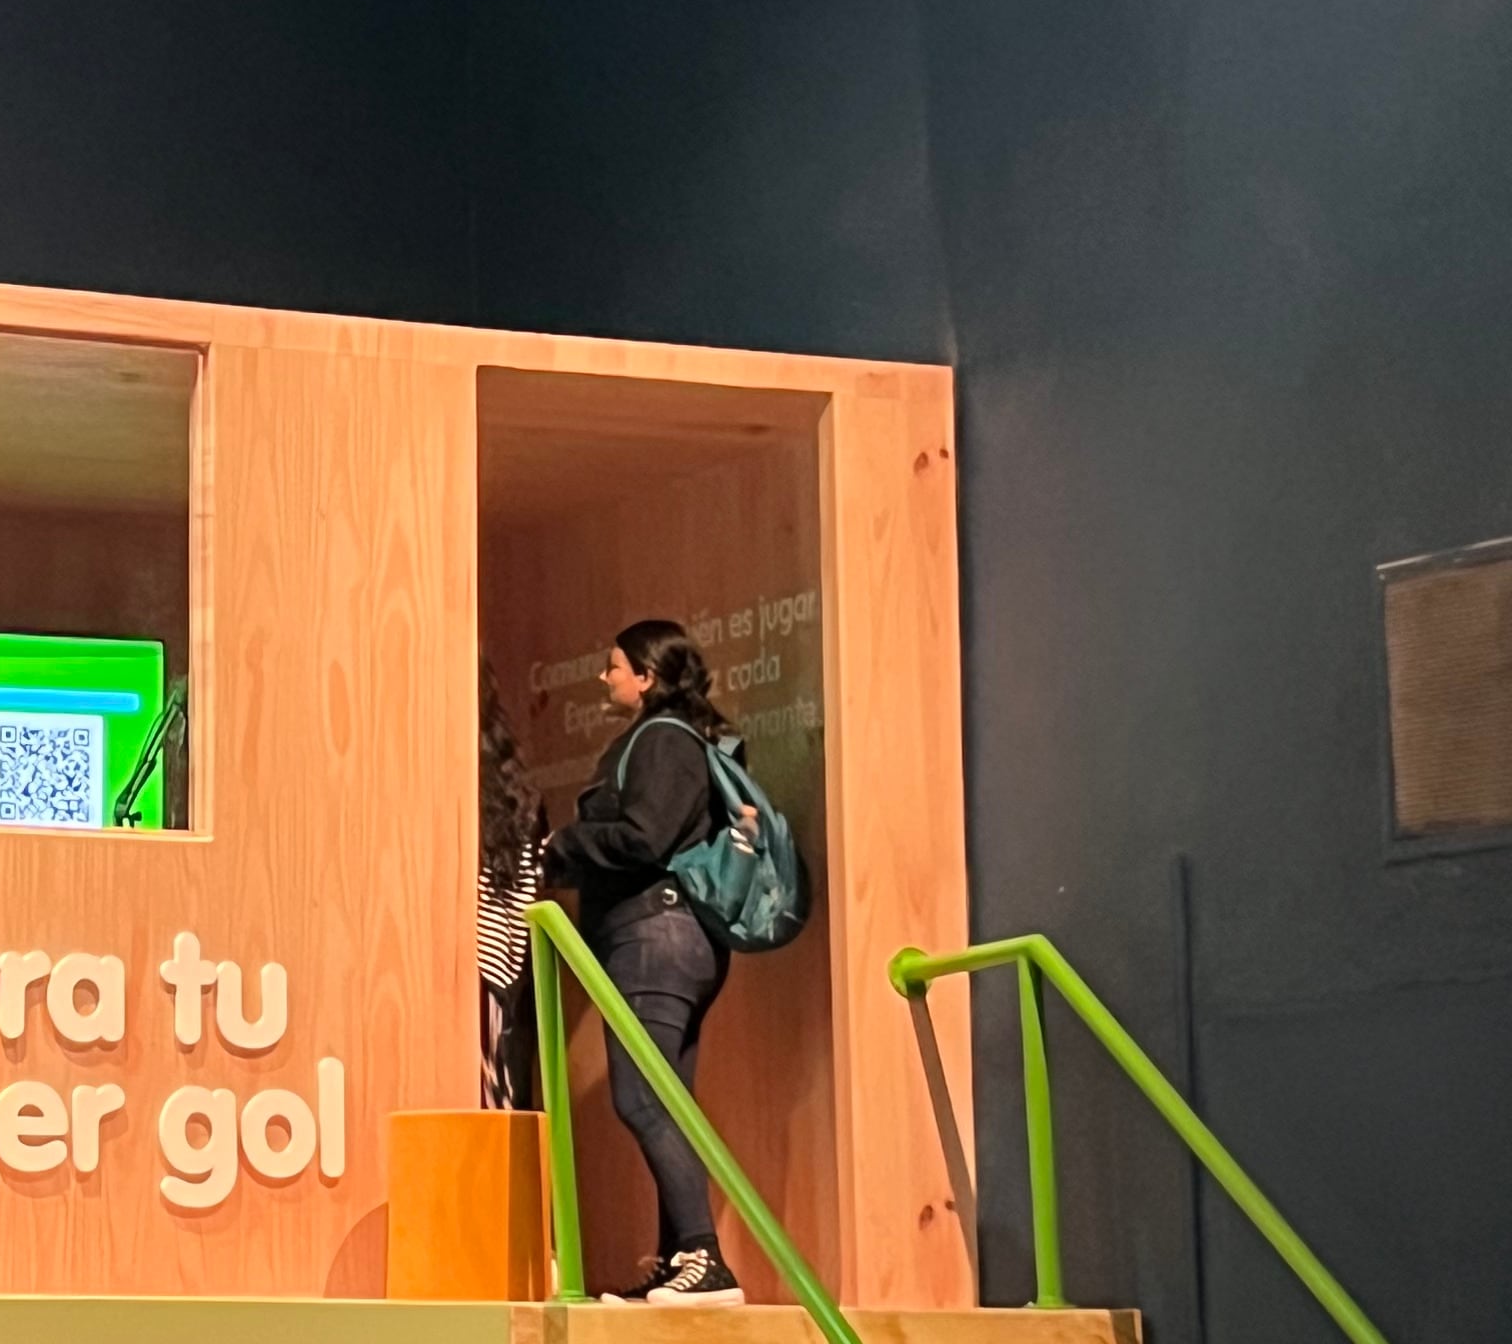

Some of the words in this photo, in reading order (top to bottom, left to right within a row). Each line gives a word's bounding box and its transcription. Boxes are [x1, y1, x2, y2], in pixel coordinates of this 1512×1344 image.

[729, 609, 753, 639] es
[758, 591, 816, 642] jugar
[159, 931, 288, 1049] tu
[158, 1057, 346, 1208] gol
